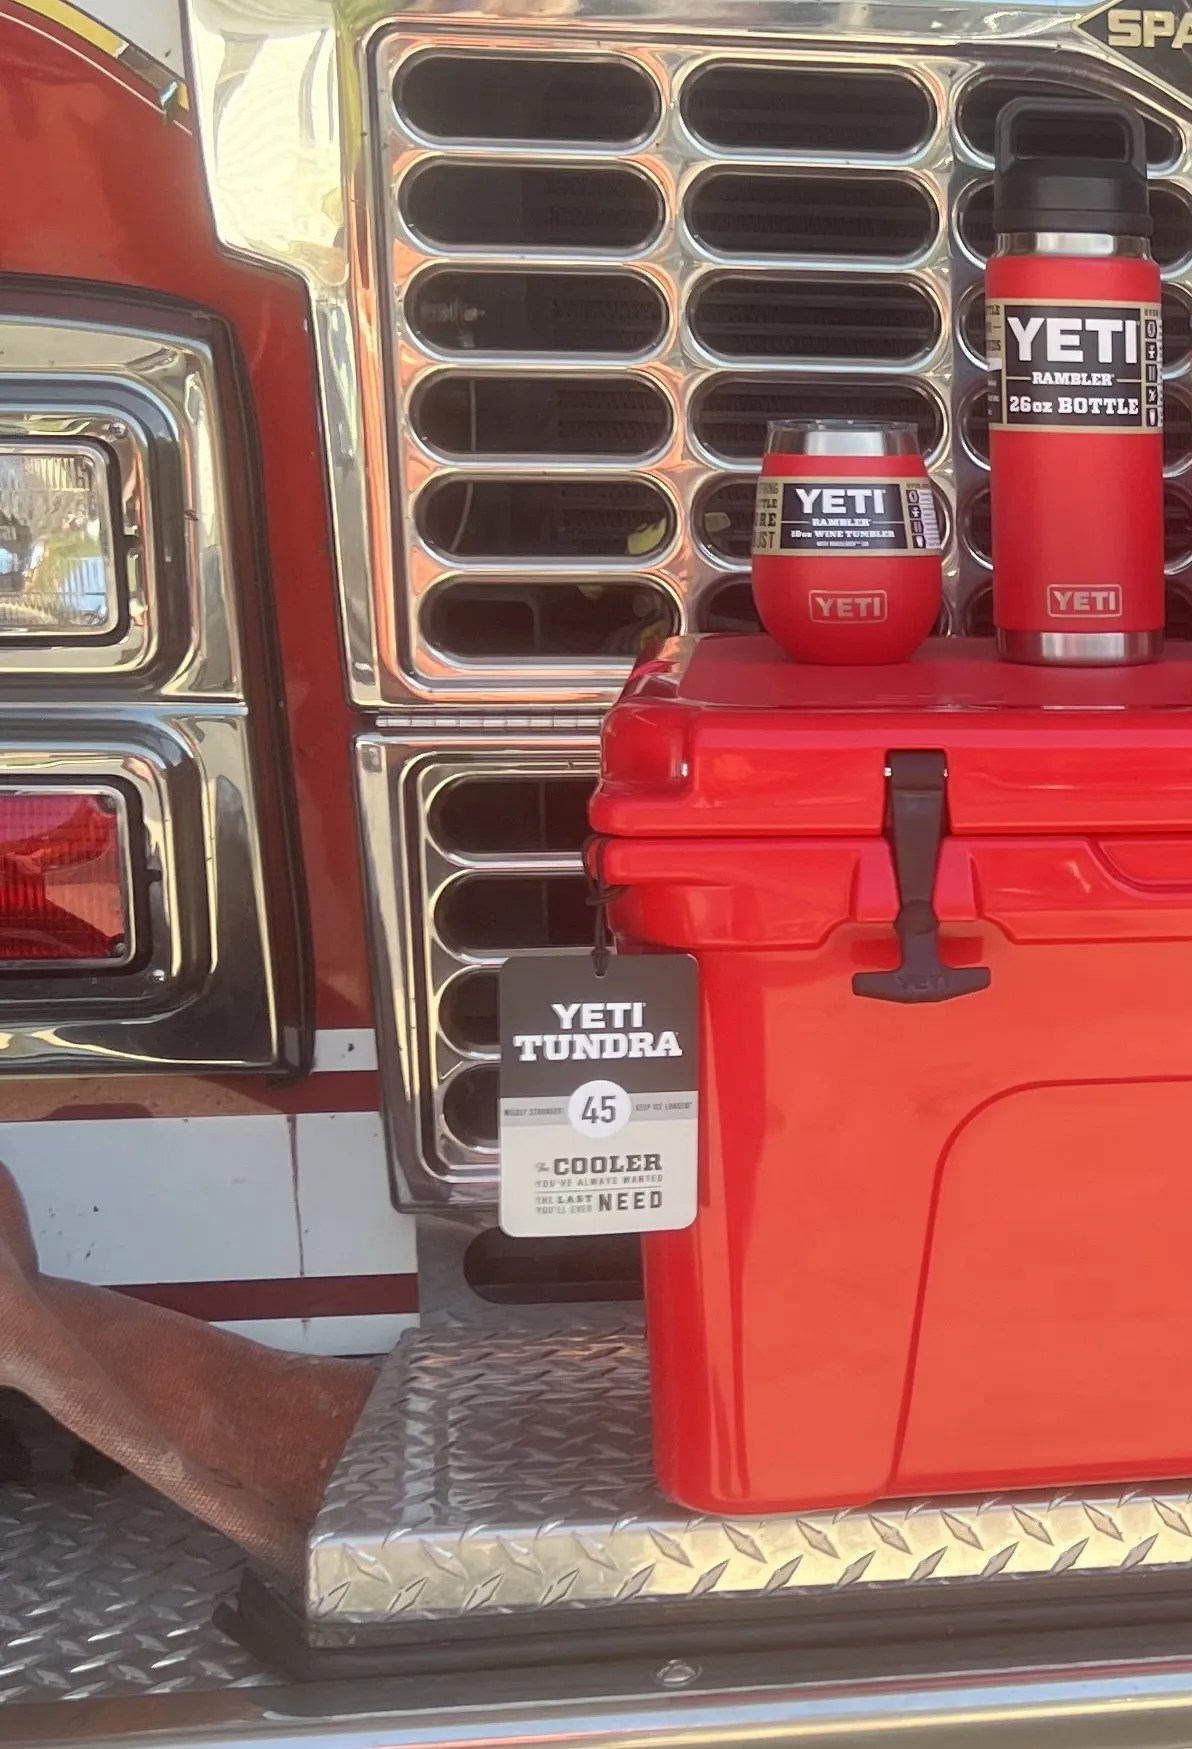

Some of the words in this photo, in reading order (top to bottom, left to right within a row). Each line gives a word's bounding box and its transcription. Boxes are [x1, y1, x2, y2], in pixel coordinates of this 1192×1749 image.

[1007, 317, 1138, 364] YETI
[1032, 371, 1113, 387] RAMBLER
[1010, 396, 1053, 413] 26oz
[1057, 397, 1139, 414] BOTTLE
[796, 488, 885, 514] YETI
[812, 518, 870, 527] RAMBLER
[814, 530, 842, 538] WINE
[844, 530, 895, 538] TUMBLER
[815, 597, 881, 617] YETI
[1053, 590, 1116, 611] YETI
[551, 1002, 643, 1030] YETI
[513, 1031, 683, 1061] TUNDRA
[581, 1095, 617, 1124] 45
[554, 1154, 662, 1175] COOLER
[536, 1179, 572, 1188] YOU'VE
[578, 1176, 617, 1187] ALWAYS
[623, 1174, 663, 1184] WANTED
[558, 1194, 593, 1204] LAST
[599, 1190, 663, 1212] NEED
